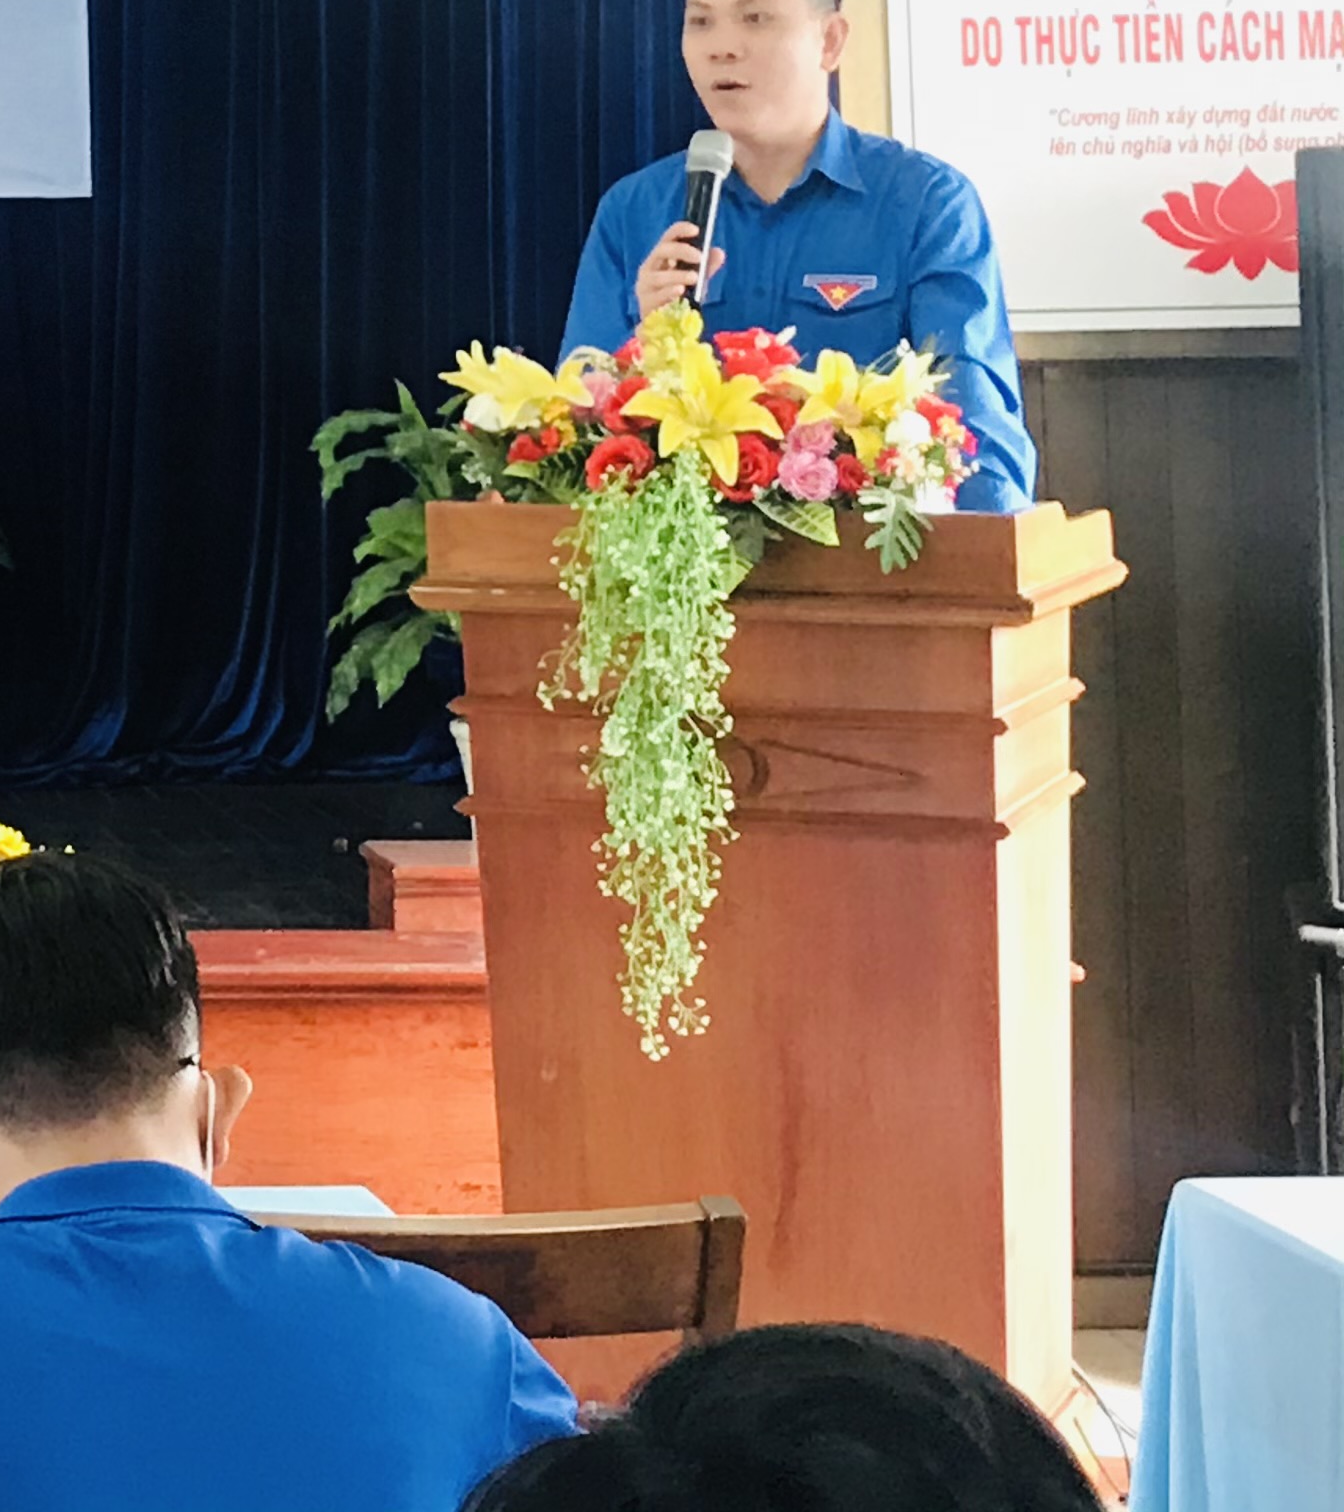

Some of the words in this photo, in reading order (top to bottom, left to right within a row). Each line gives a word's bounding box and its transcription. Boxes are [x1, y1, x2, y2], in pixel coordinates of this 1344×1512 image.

[961, 16, 1003, 67] DO
[1014, 9, 1101, 77] THỰC
[1197, 0, 1285, 63] CÁCH
[1203, 104, 1251, 129] dựng
[1290, 102, 1339, 122] nước
[1049, 137, 1076, 156] lên
[1121, 136, 1171, 159] nghĩa
[1205, 134, 1233, 156] hội
